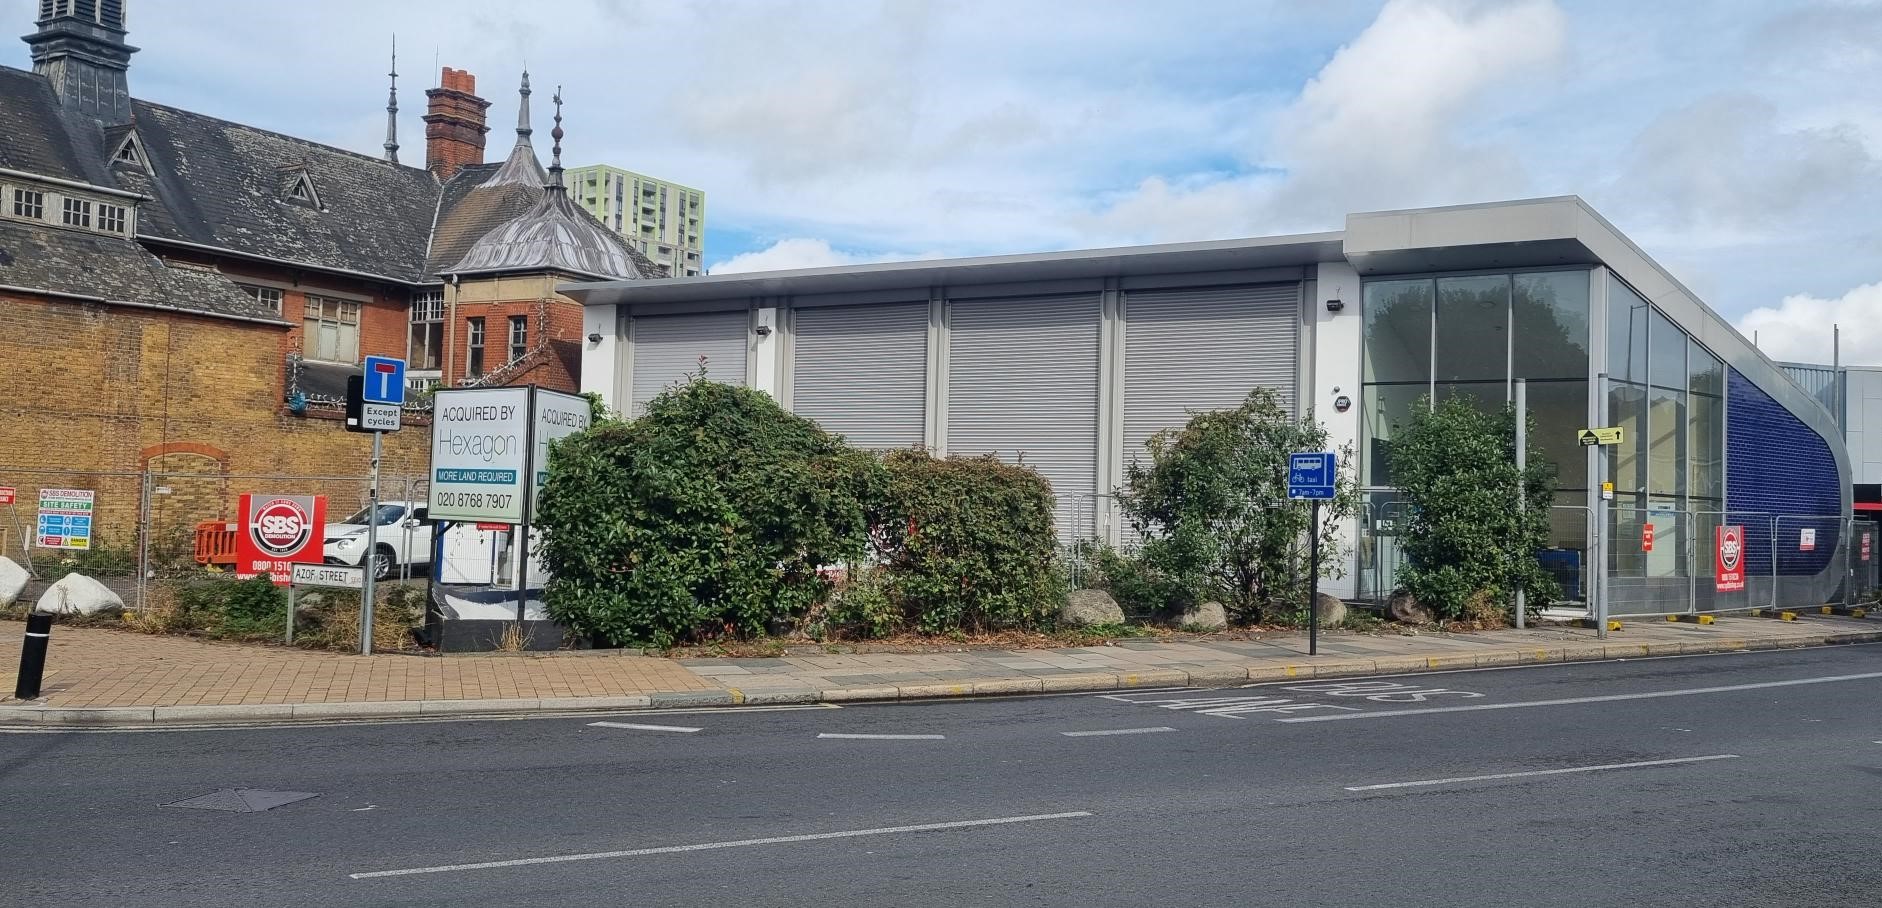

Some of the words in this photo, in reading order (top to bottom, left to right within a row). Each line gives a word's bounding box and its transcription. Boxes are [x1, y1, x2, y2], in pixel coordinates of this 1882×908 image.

[367, 407, 398, 417] Except
[442, 406, 497, 421] ACQUIRED
[500, 405, 516, 420] BY
[541, 408, 577, 428] ACQUIRED
[578, 414, 588, 429] BY
[367, 418, 396, 426] cycles
[439, 429, 517, 462] Hexagon
[438, 470, 457, 480] MORE
[458, 471, 477, 481] LAND
[478, 472, 513, 482] REQUIRED
[1307, 475, 1318, 483] taxi
[60, 490, 93, 498] DEMOLITION
[437, 492, 455, 507] 020
[457, 492, 483, 508] 8768
[486, 493, 512, 509] 7907
[61, 501, 87, 509] SAFETY
[262, 515, 299, 534] SBS
[1724, 540, 1737, 552] SBS
[252, 560, 271, 570] 0800
[295, 568, 315, 580] AZOF
[319, 570, 348, 582] STREET
[1280, 681, 1486, 702] BUS
[1094, 689, 1363, 720] LANE
